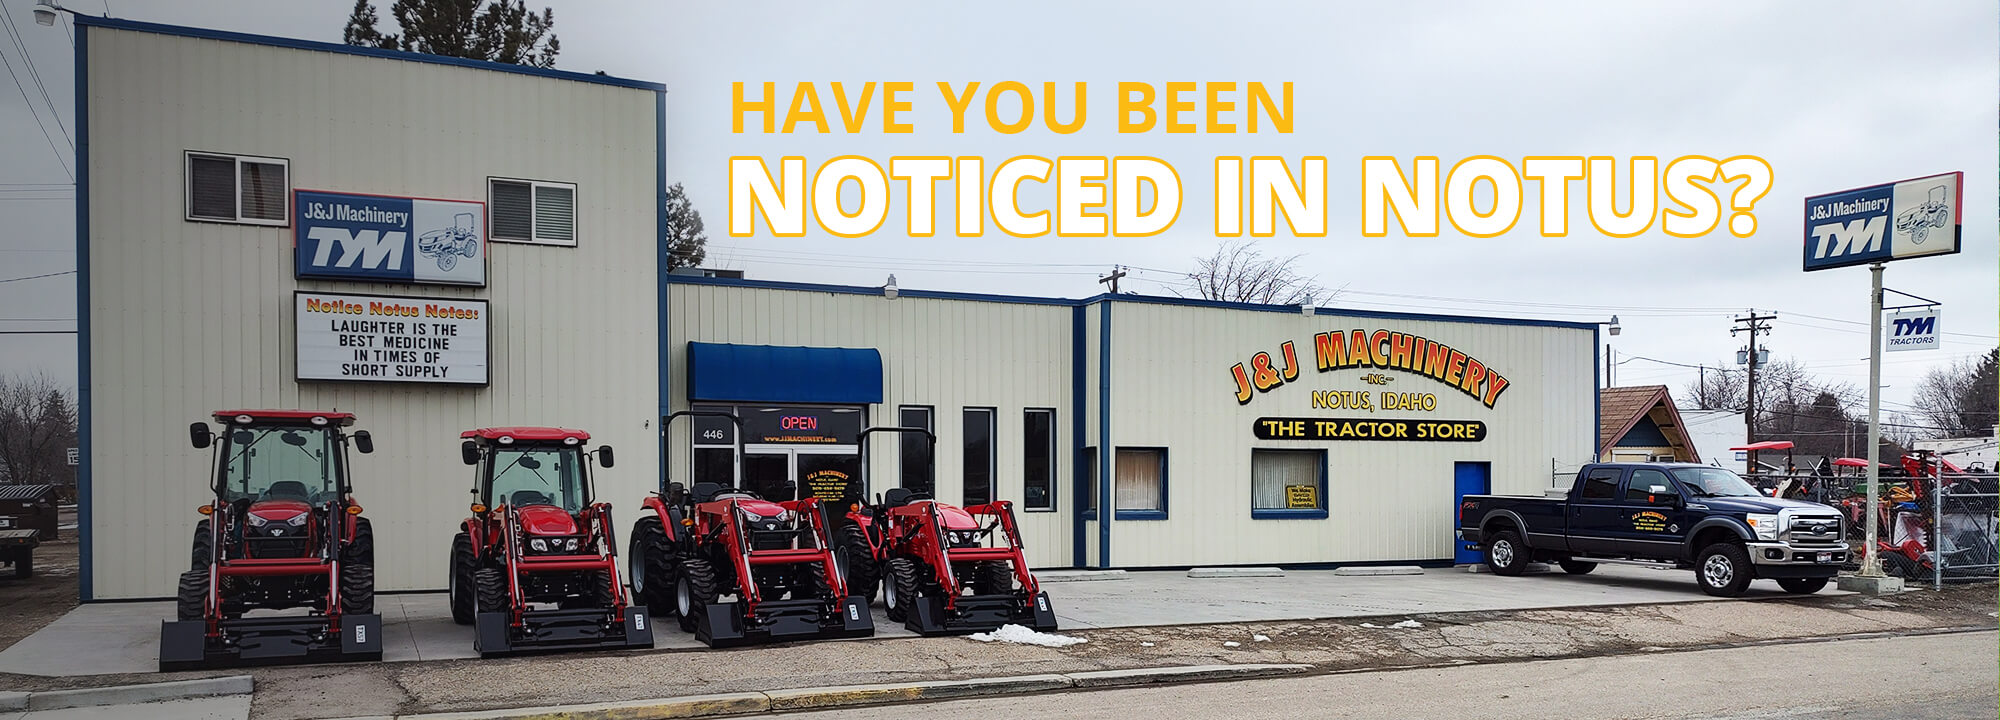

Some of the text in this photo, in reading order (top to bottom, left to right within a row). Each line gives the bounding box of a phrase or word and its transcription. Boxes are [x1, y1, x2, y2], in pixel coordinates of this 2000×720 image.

[304, 202, 408, 228] J&J Machinery
[1810, 197, 1890, 221] J&J Machinery
[1811, 215, 1888, 260] TYM
[307, 226, 407, 271] TYM
[306, 298, 479, 320] Notice Notus Notes:
[331, 319, 457, 336] LAUGHTER IS THE
[1892, 316, 1936, 336] TYM
[339, 335, 449, 350] BEST MEDICINE
[1889, 336, 1934, 346] TRACTORS
[354, 349, 440, 364] IN TIMES OF
[342, 363, 449, 378] SHORT SUPPLY
[1230, 329, 1510, 410] J&J MACHINERY
[1312, 390, 1437, 413] NOTUS, IDAHO
[781, 416, 817, 430] OPEN
[1315, 421, 1408, 438] TRACTOR
[703, 430, 723, 440] 446
